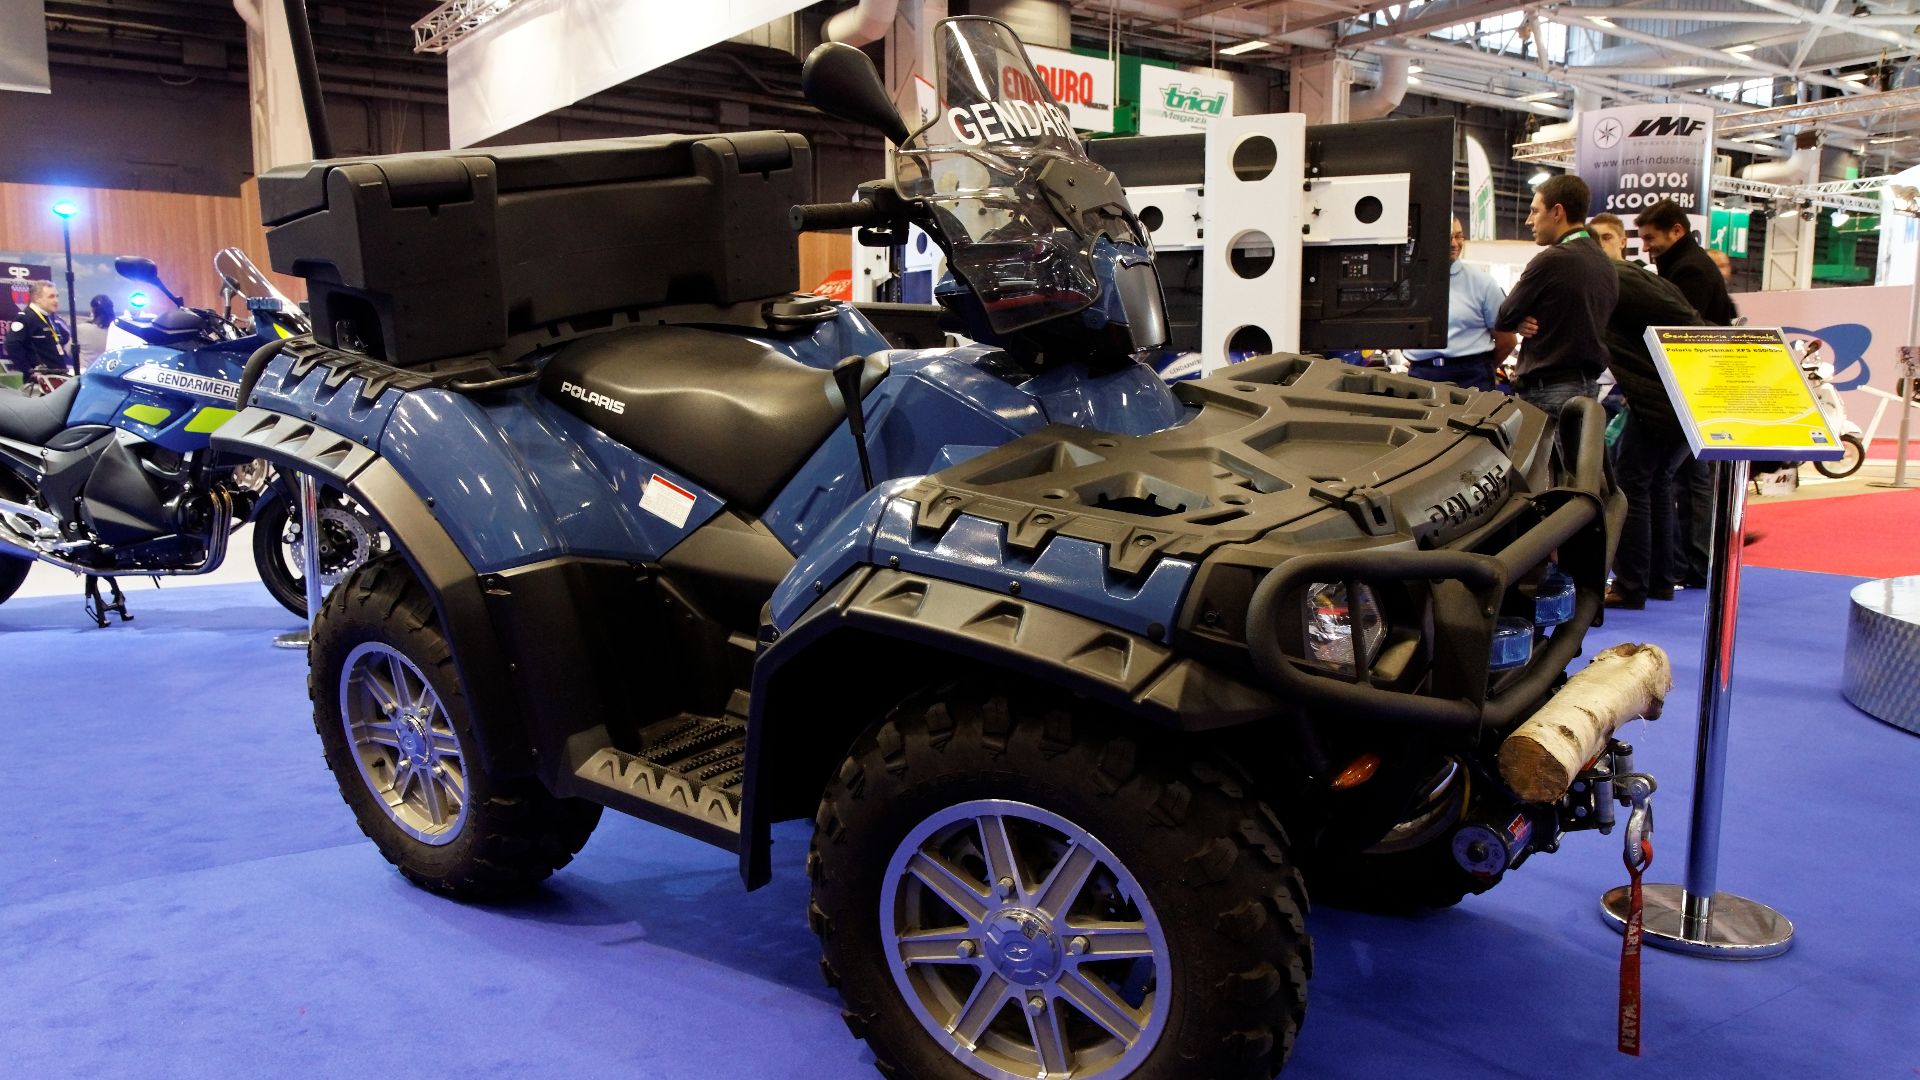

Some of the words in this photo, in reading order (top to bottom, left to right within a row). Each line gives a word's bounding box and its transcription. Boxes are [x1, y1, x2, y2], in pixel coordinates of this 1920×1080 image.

[1160, 84, 1227, 116] trial
[1628, 117, 1705, 137] IMF
[1620, 172, 1688, 189] MOTOS
[157, 372, 241, 398] GENDARMERIE
[561, 381, 626, 415] POLARIS
